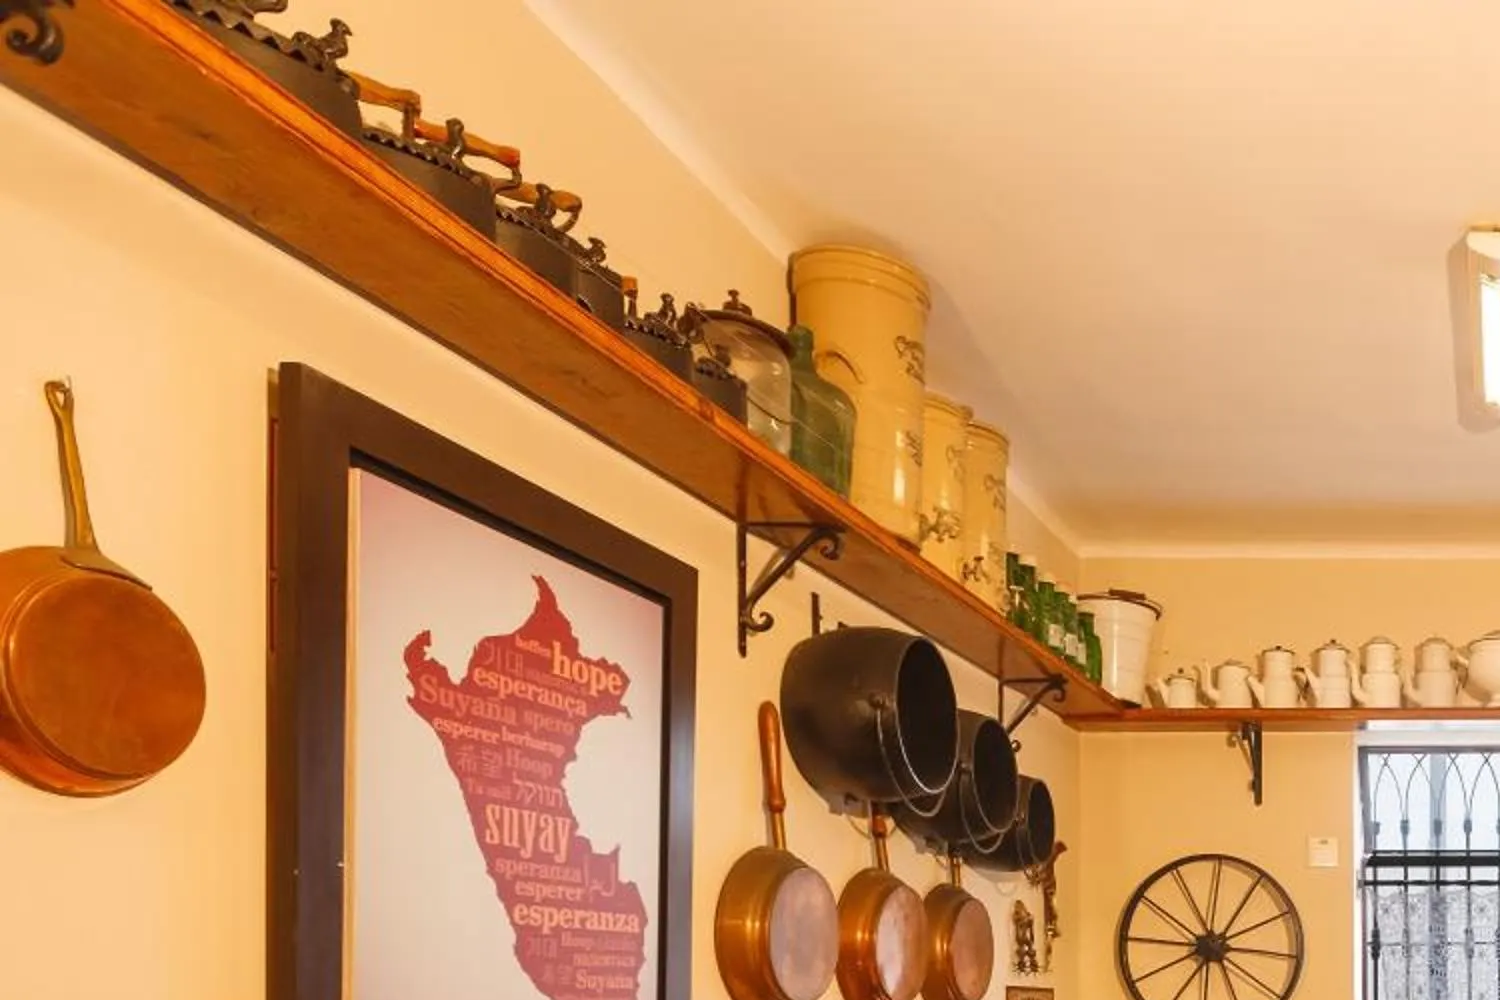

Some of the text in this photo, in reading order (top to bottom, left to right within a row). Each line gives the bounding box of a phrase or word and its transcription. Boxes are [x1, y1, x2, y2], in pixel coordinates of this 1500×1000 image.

[473, 666, 588, 718] esperança
[553, 640, 623, 696] hope
[485, 803, 574, 864] suyay
[495, 857, 582, 883] speranza
[513, 902, 641, 935] esperanza
